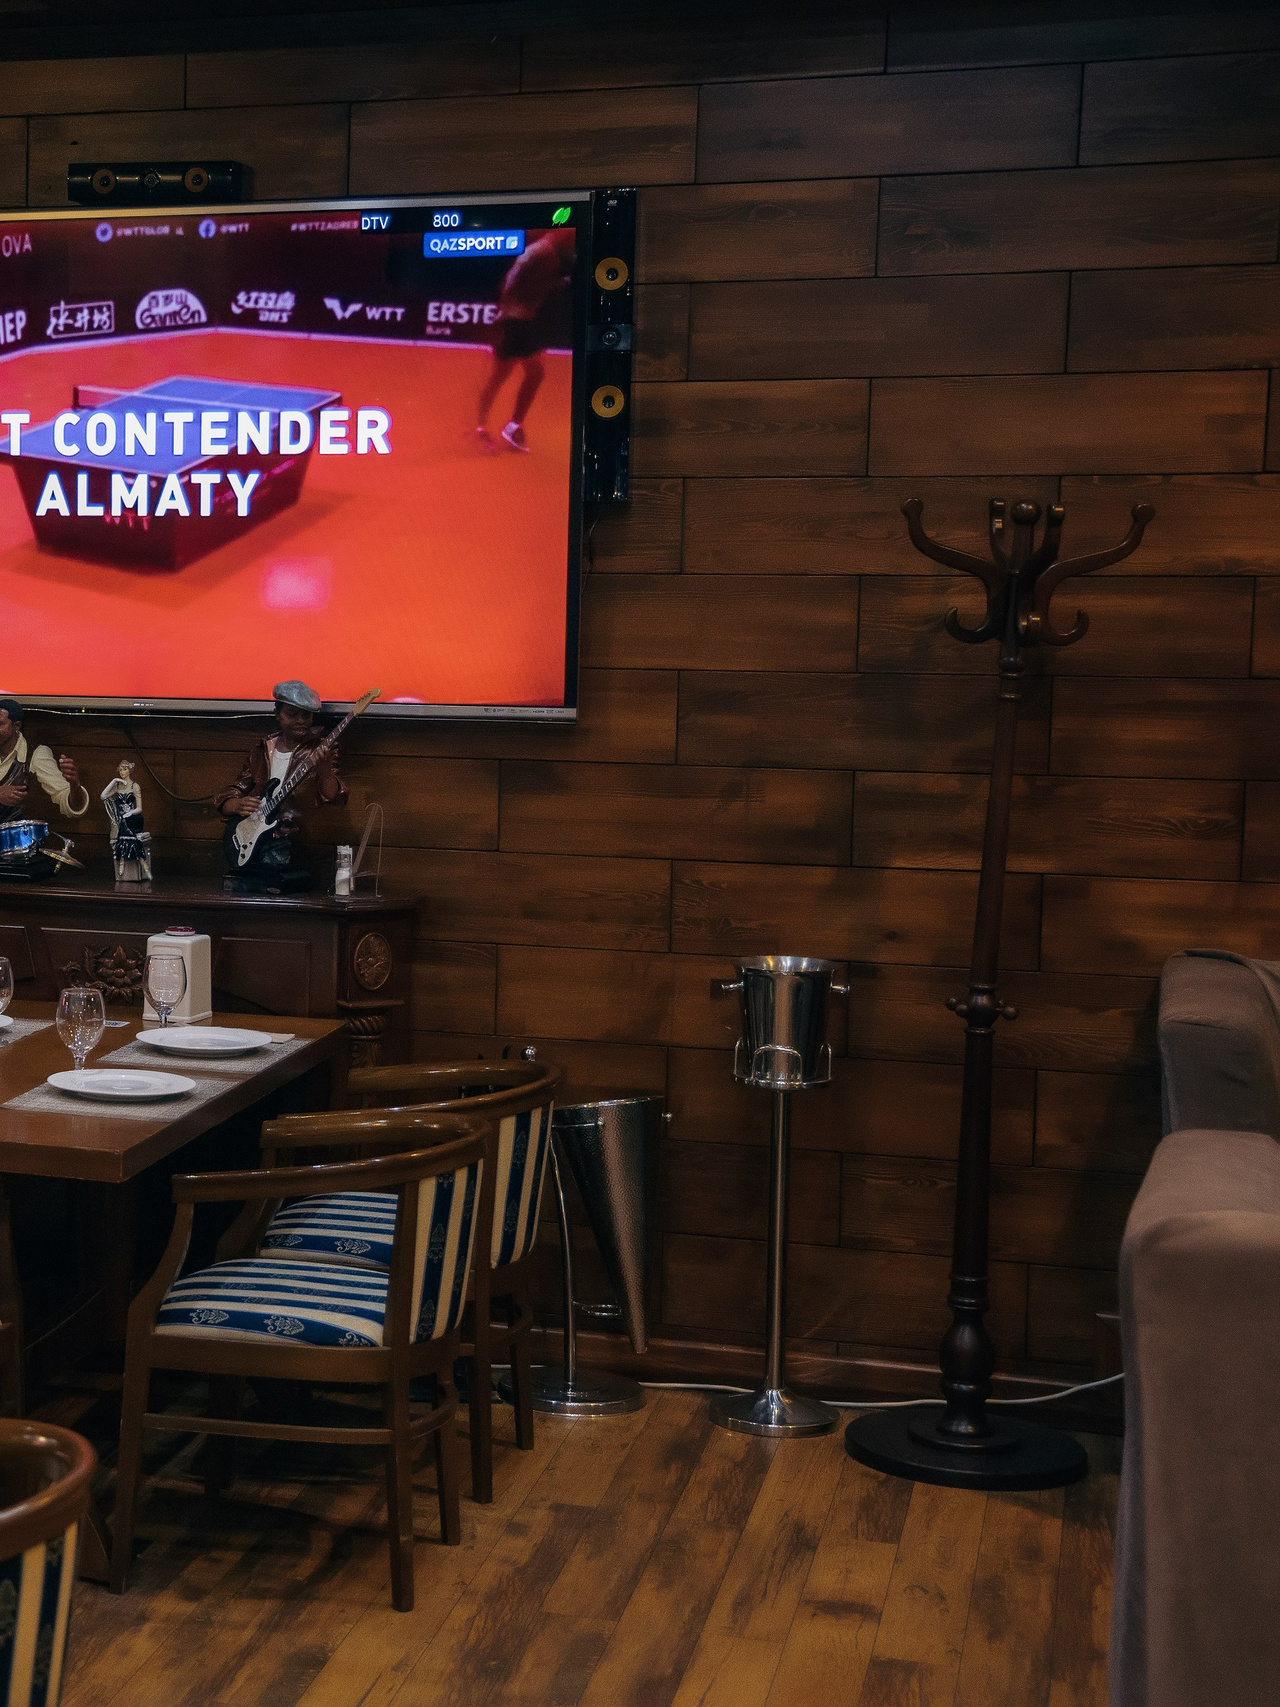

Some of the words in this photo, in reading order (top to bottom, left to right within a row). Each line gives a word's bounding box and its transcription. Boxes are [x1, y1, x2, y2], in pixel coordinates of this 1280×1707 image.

[361, 217, 389, 230] DTV
[433, 214, 459, 228] 800
[429, 236, 505, 254] QAZSPORT
[366, 306, 406, 322] WTT
[427, 302, 499, 325] ERSTE
[53, 410, 392, 456] CONTENDER
[36, 473, 260, 517] ALMATY
